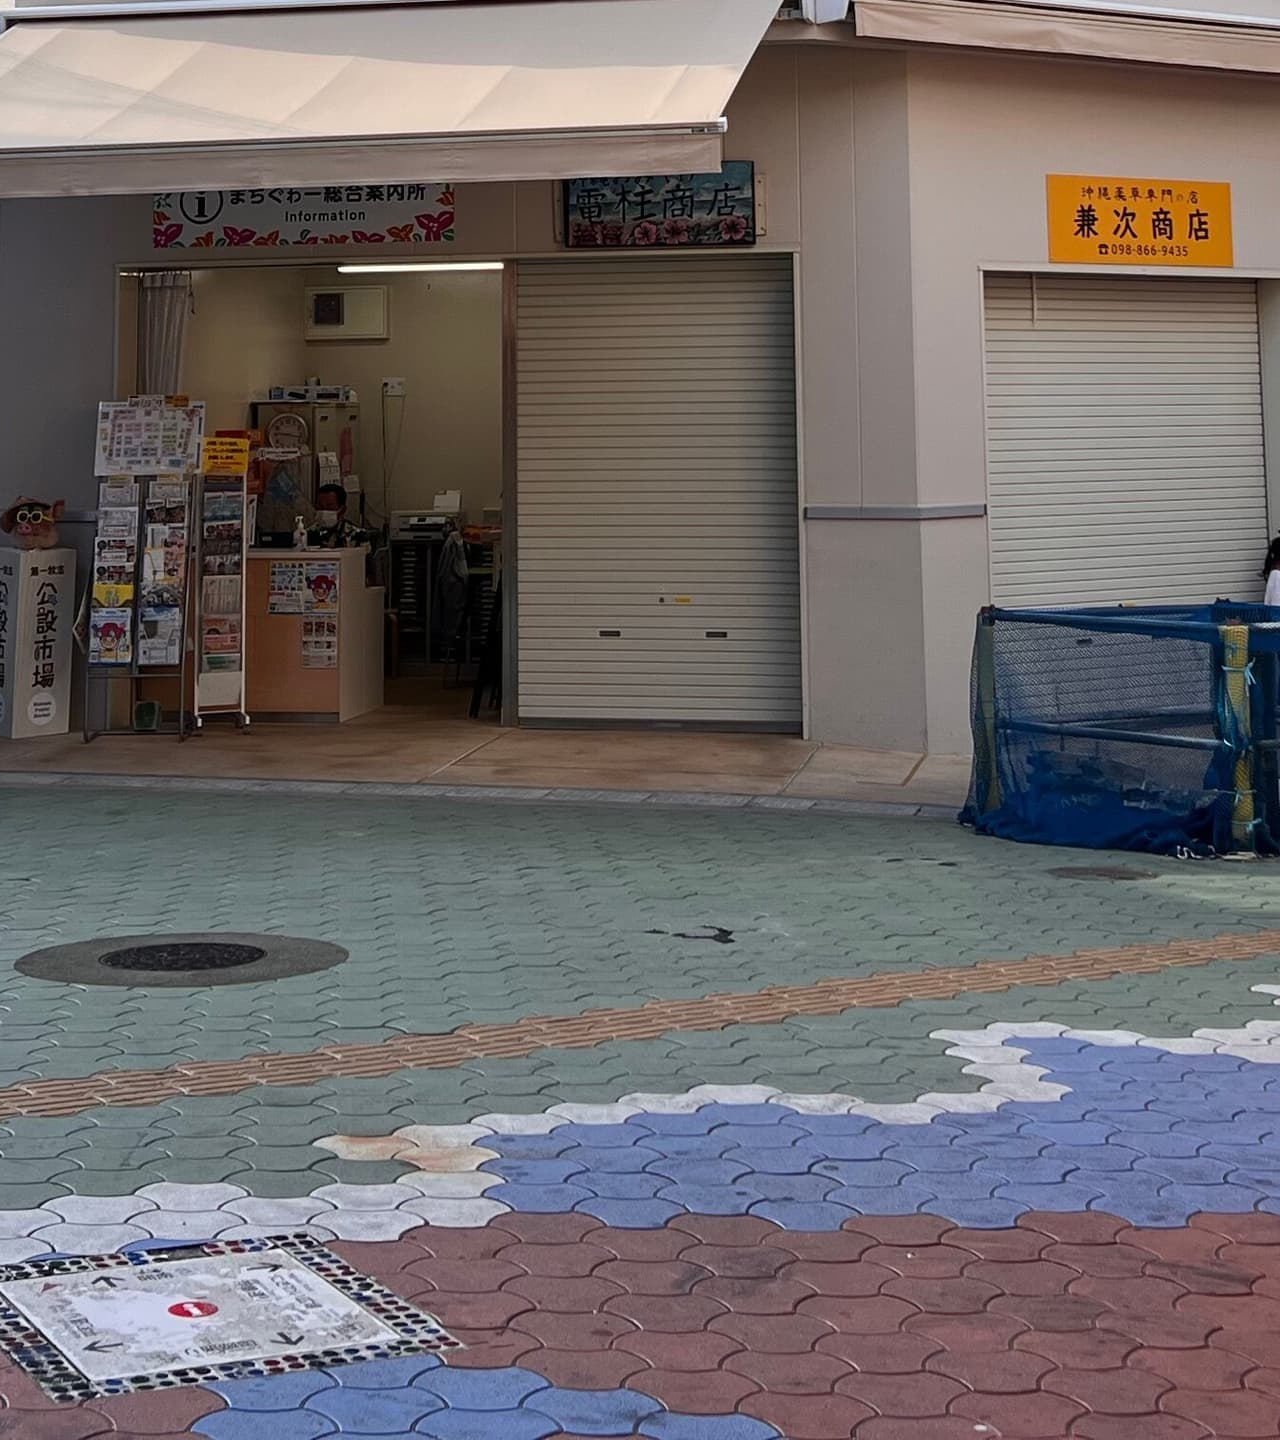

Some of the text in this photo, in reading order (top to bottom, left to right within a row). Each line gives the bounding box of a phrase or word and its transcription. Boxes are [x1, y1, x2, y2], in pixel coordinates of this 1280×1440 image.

[285, 209, 366, 223] Information
[576, 182, 741, 225] 電柱商店
[1074, 203, 1210, 242] 兼次商店
[1111, 244, 1189, 257] 098-866-9435
[31, 581, 58, 689] 公設市場
